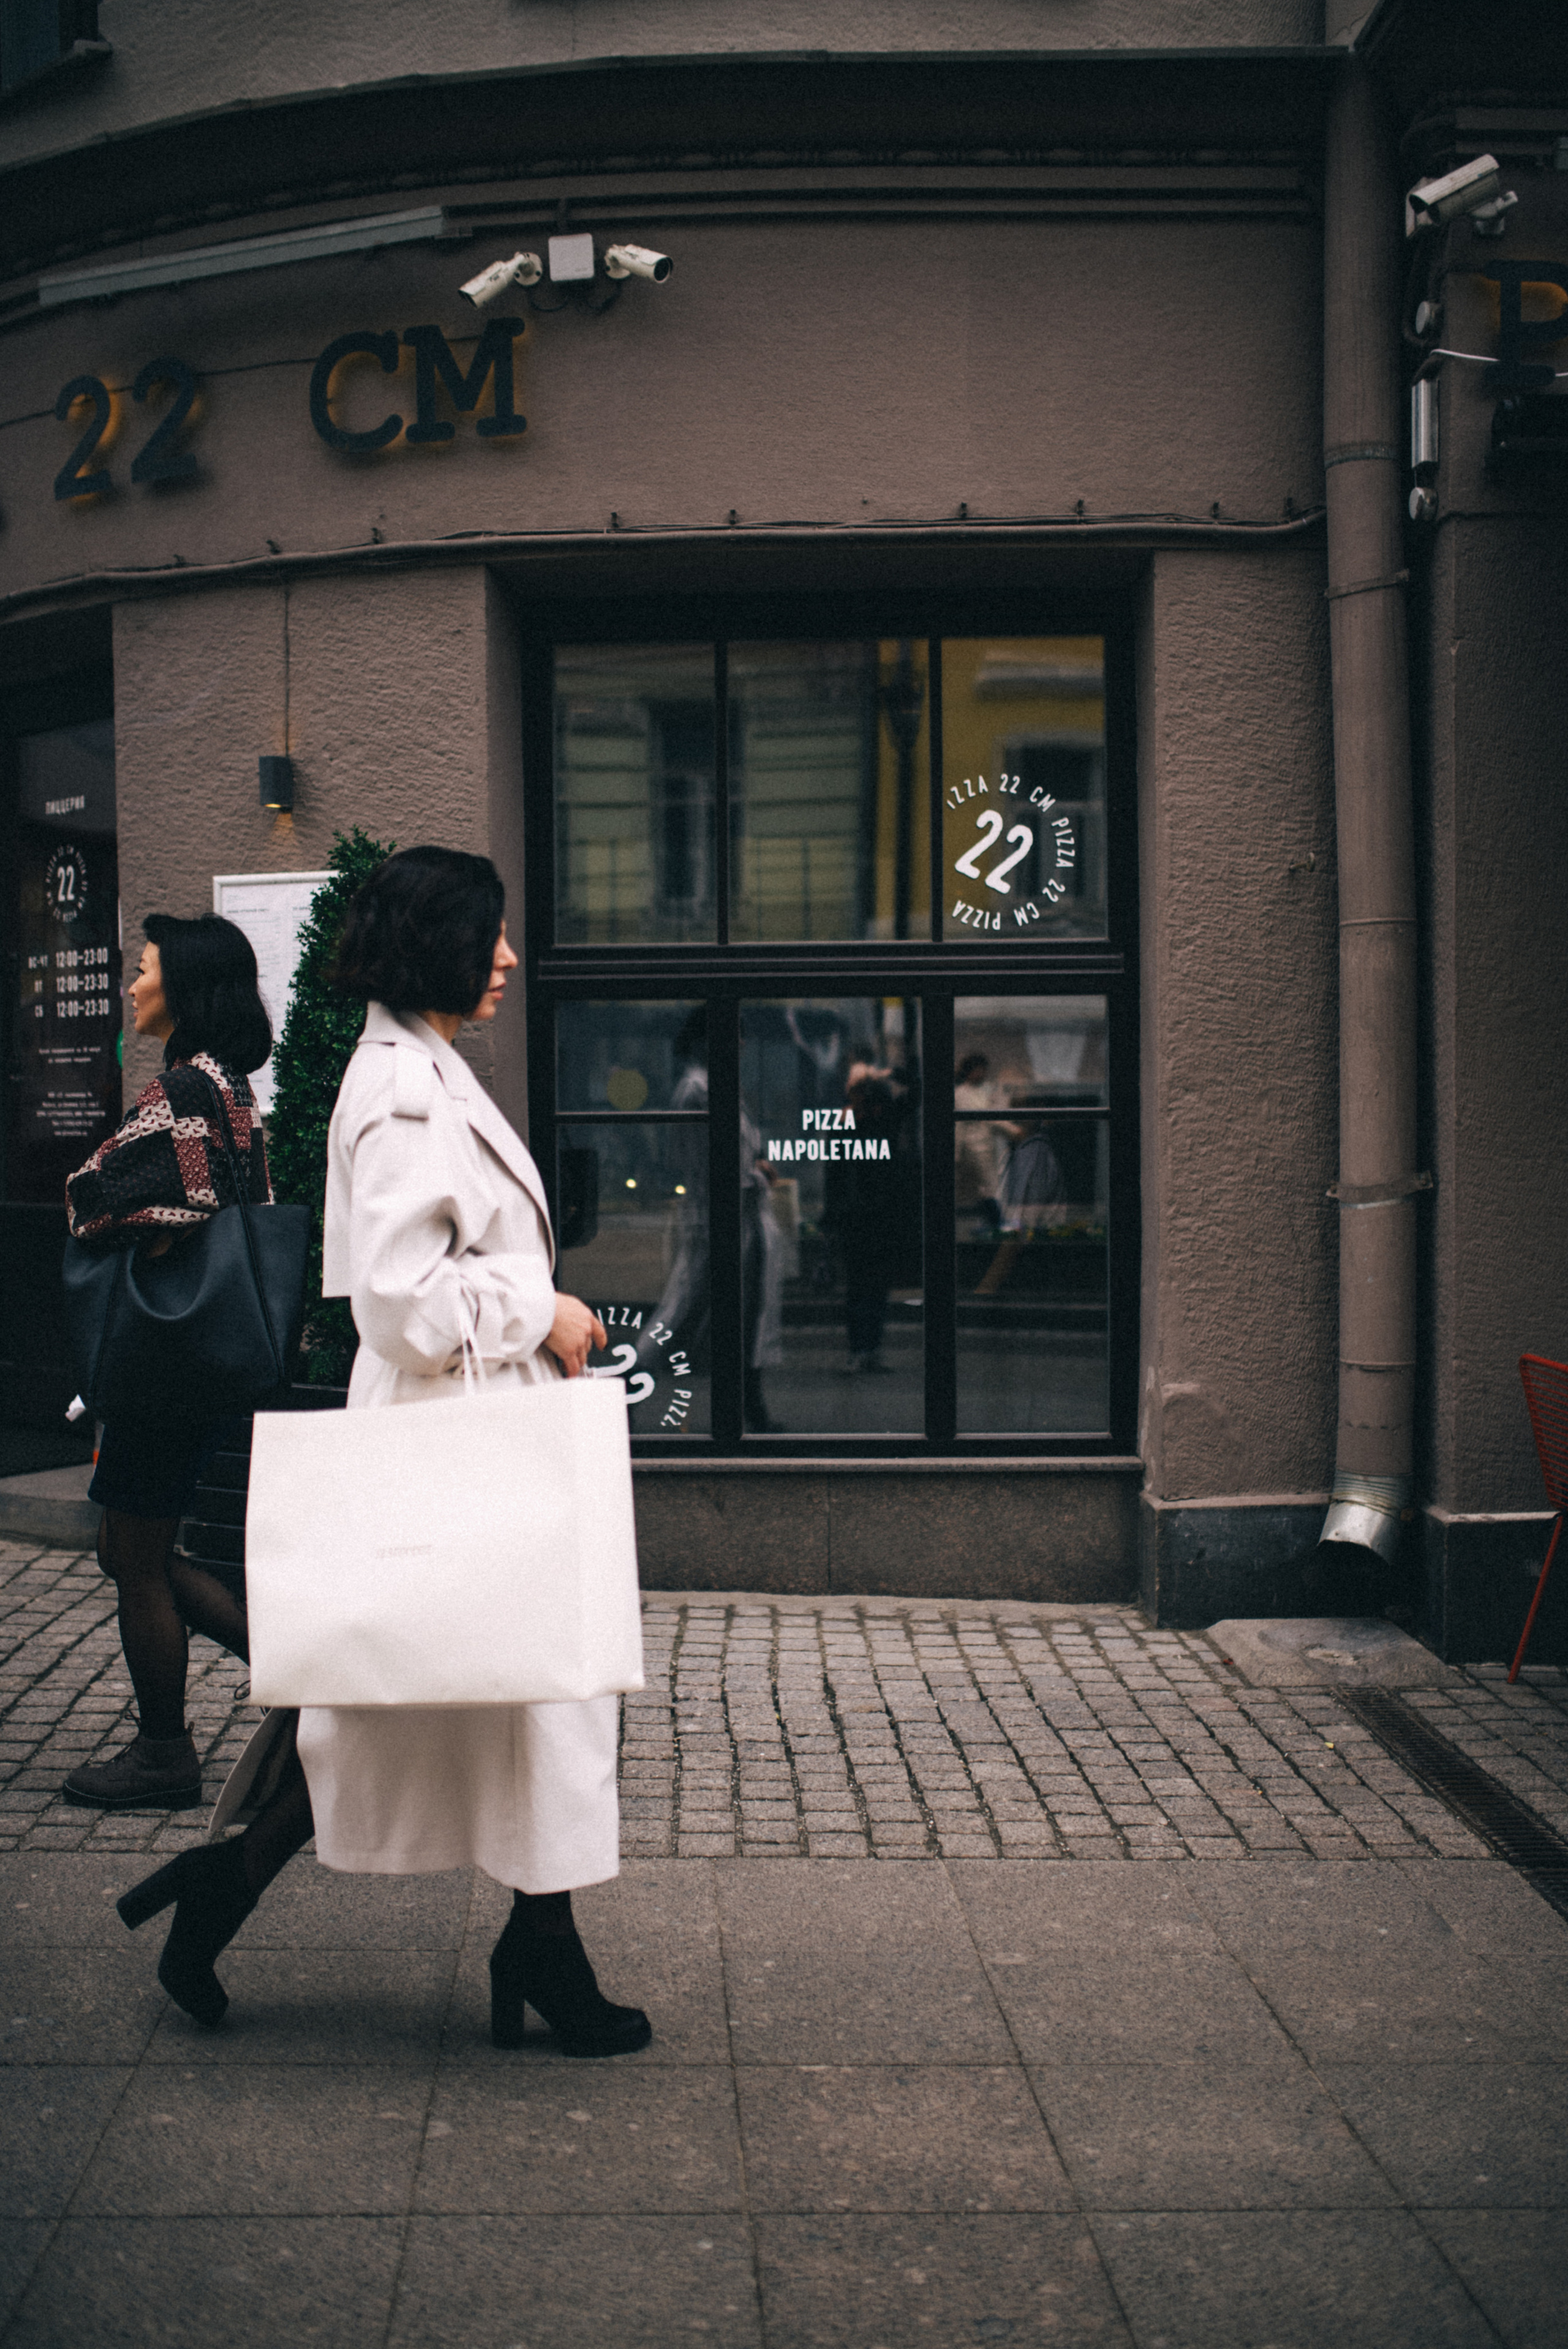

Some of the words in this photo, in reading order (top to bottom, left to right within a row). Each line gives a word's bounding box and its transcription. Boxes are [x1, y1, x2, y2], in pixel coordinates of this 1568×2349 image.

[54, 357, 198, 501] 22
[309, 316, 528, 453] CM
[946, 775, 989, 809] IZZA
[999, 773, 1020, 794] 22
[1029, 786, 1056, 812] CM
[954, 809, 1034, 895] 22
[1051, 817, 1076, 868] PIZZA
[57, 864, 75, 902] 22
[1042, 879, 1066, 902] 22
[952, 900, 1001, 930] PIZZA
[1014, 902, 1040, 926] CM
[56, 947, 108, 968] 12:00-23:00
[802, 1109, 856, 1130] PIZZA
[768, 1139, 891, 1161] NAPOLETANA
[597, 1306, 643, 1330] IZZA
[649, 1322, 673, 1346] 22
[669, 1351, 691, 1376] CM
[660, 1389, 692, 1427] PIZZ
